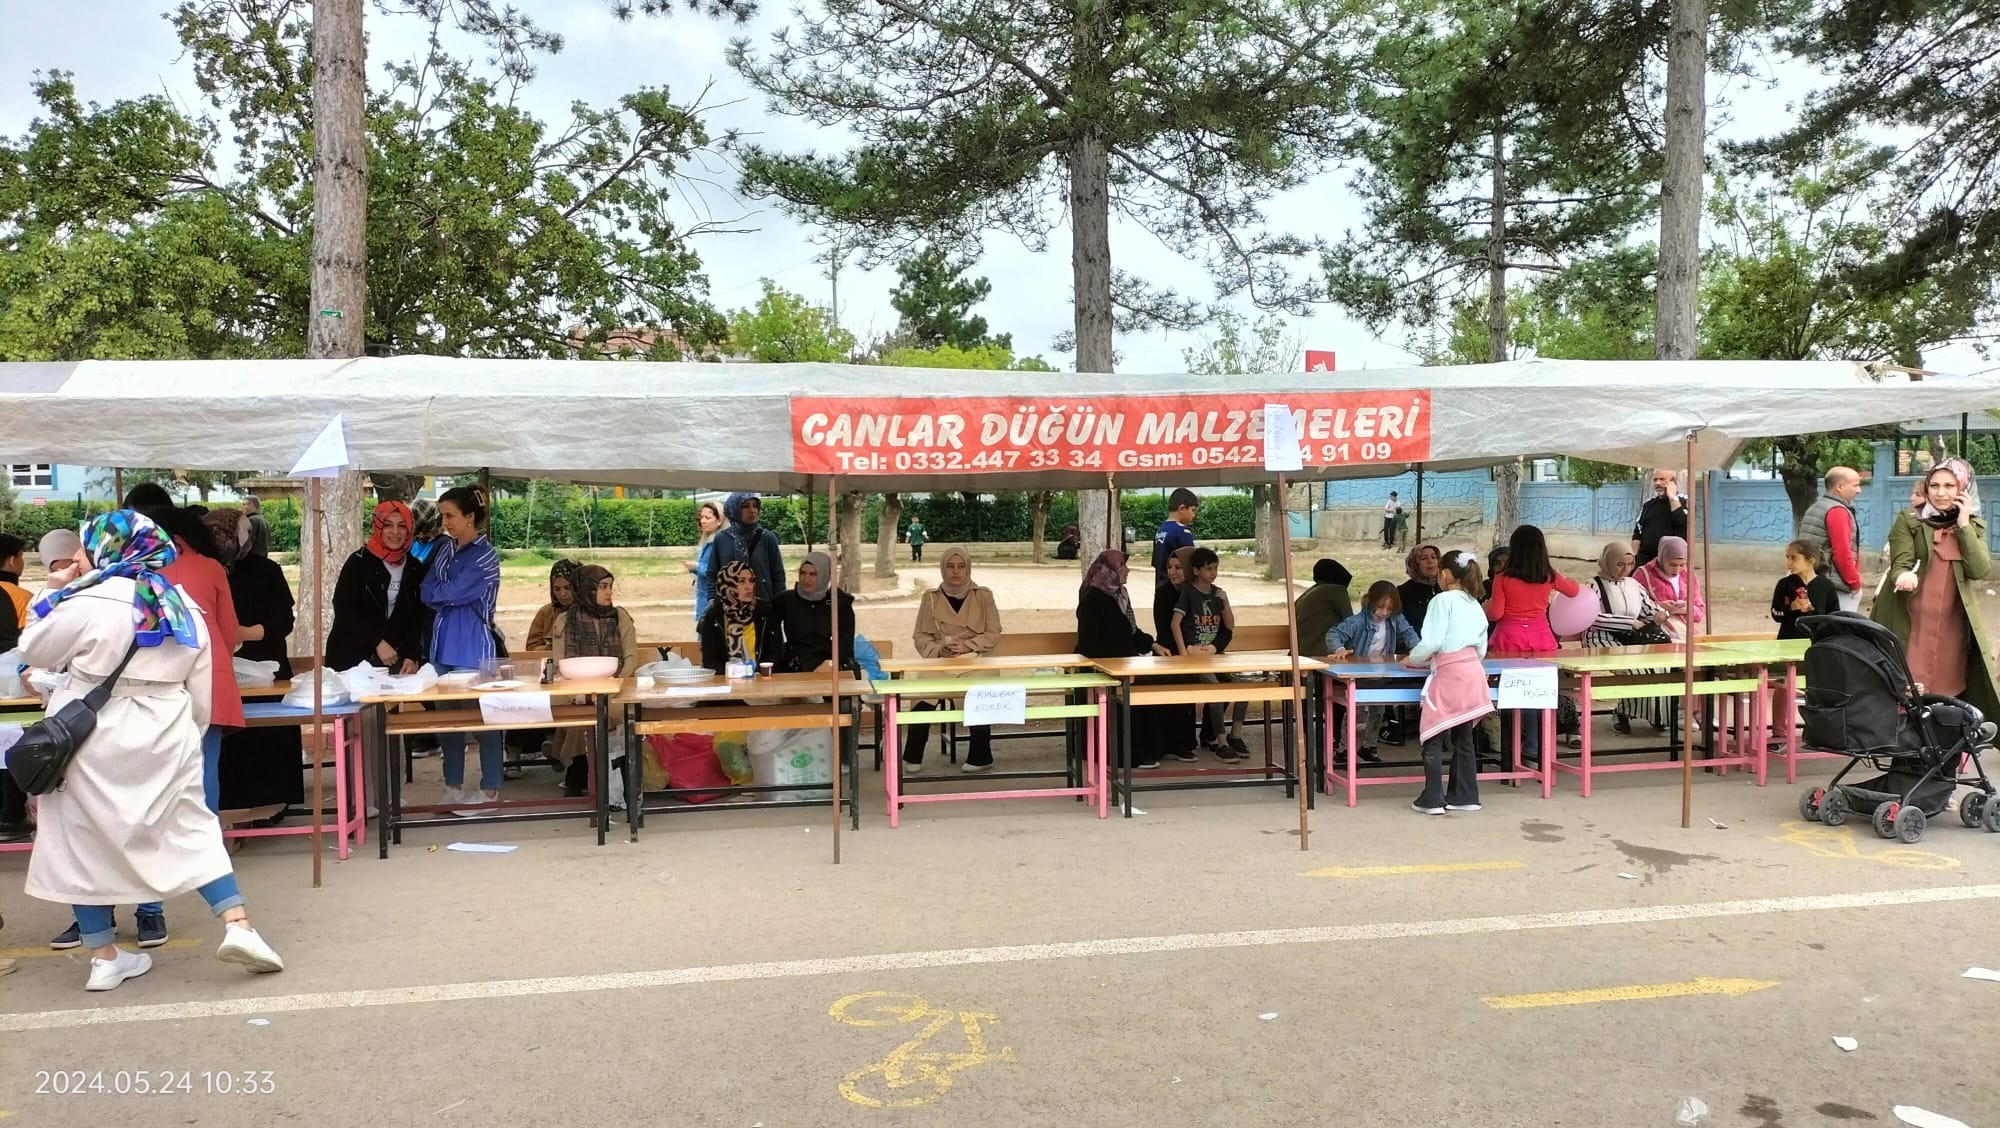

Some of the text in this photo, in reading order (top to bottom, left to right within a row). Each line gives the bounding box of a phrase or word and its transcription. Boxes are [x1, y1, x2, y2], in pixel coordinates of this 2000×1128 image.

[801, 412, 966, 449] CANLAR
[980, 404, 1125, 447] DÜĞÜN
[1135, 397, 1421, 445] MALZEELERİ
[836, 442, 1391, 470] Tel: 0332.447 33 34 Gsm: 0542.4 91 09
